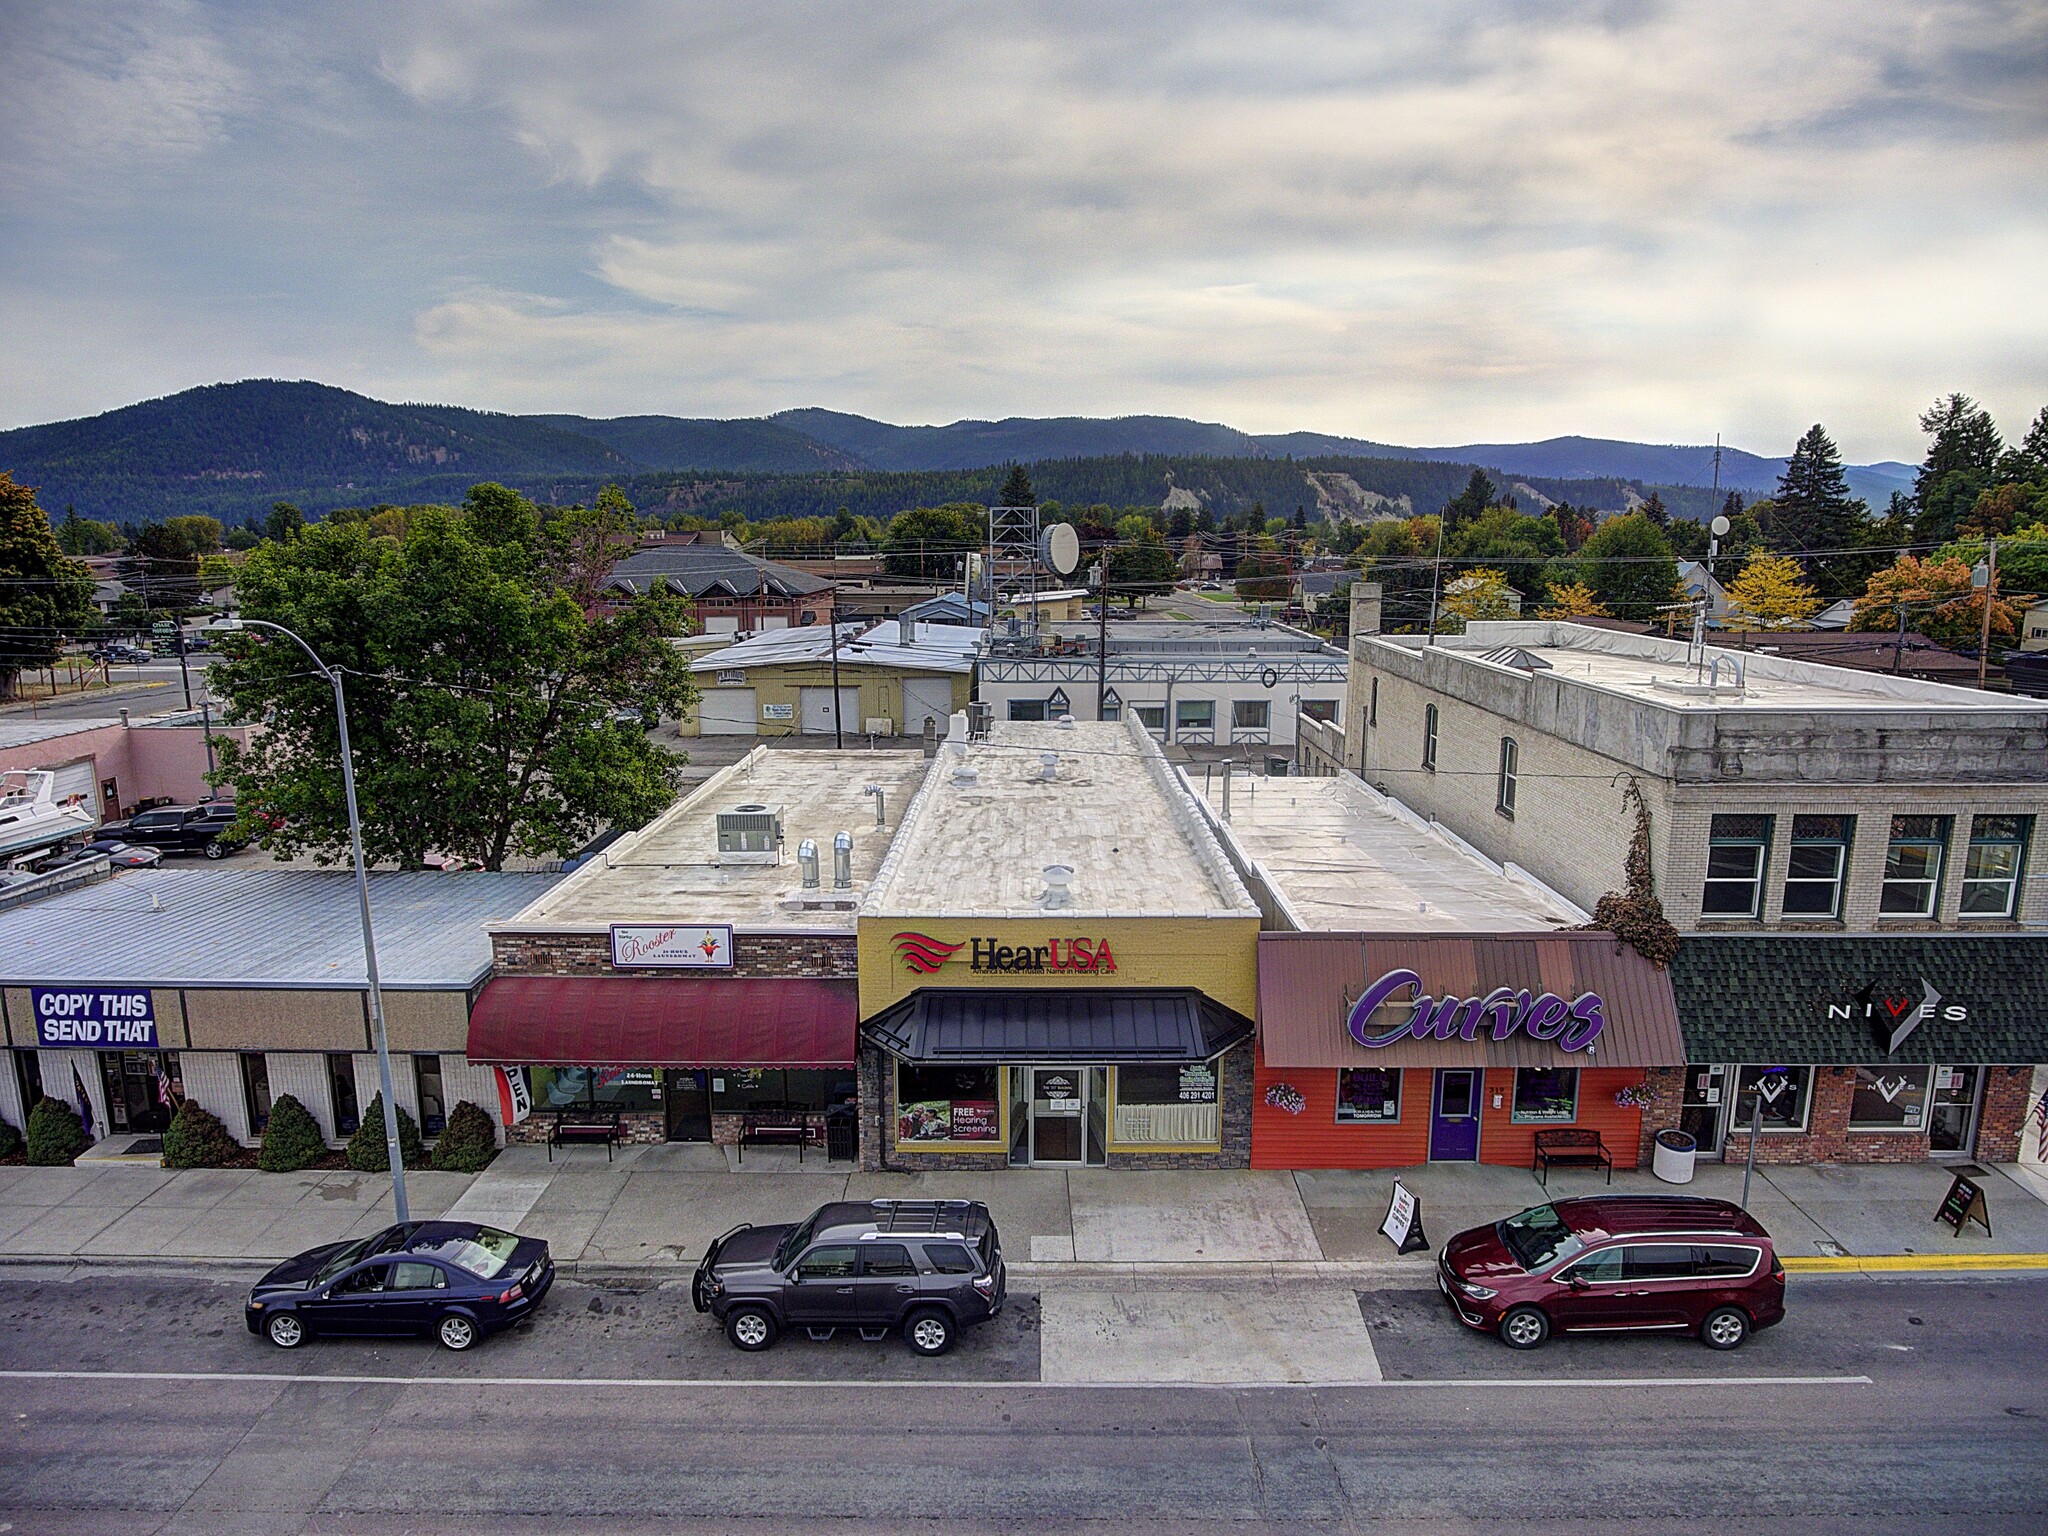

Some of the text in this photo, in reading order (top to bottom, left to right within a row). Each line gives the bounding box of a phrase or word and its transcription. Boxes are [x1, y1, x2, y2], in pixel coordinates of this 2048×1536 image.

[621, 929, 677, 962] Rooster
[970, 937, 1118, 970] HearUSA
[1075, 968, 1099, 976] Hearing
[39, 993, 148, 1018] COPY THIS
[1346, 968, 1606, 1053] Curves
[1828, 995, 1967, 1022] NIVES
[43, 1019, 154, 1043] SEND THAT
[505, 1065, 528, 1114] PEN
[1488, 1086, 1505, 1094] 319
[1748, 1082, 1798, 1091] NIVES
[1867, 1081, 1916, 1091] NIVES
[1190, 1091, 1201, 1099] 291
[1201, 1091, 1215, 1099] 4201
[953, 1107, 975, 1117] FREE
[953, 1116, 988, 1126] Hearing
[953, 1125, 997, 1134] Screening
